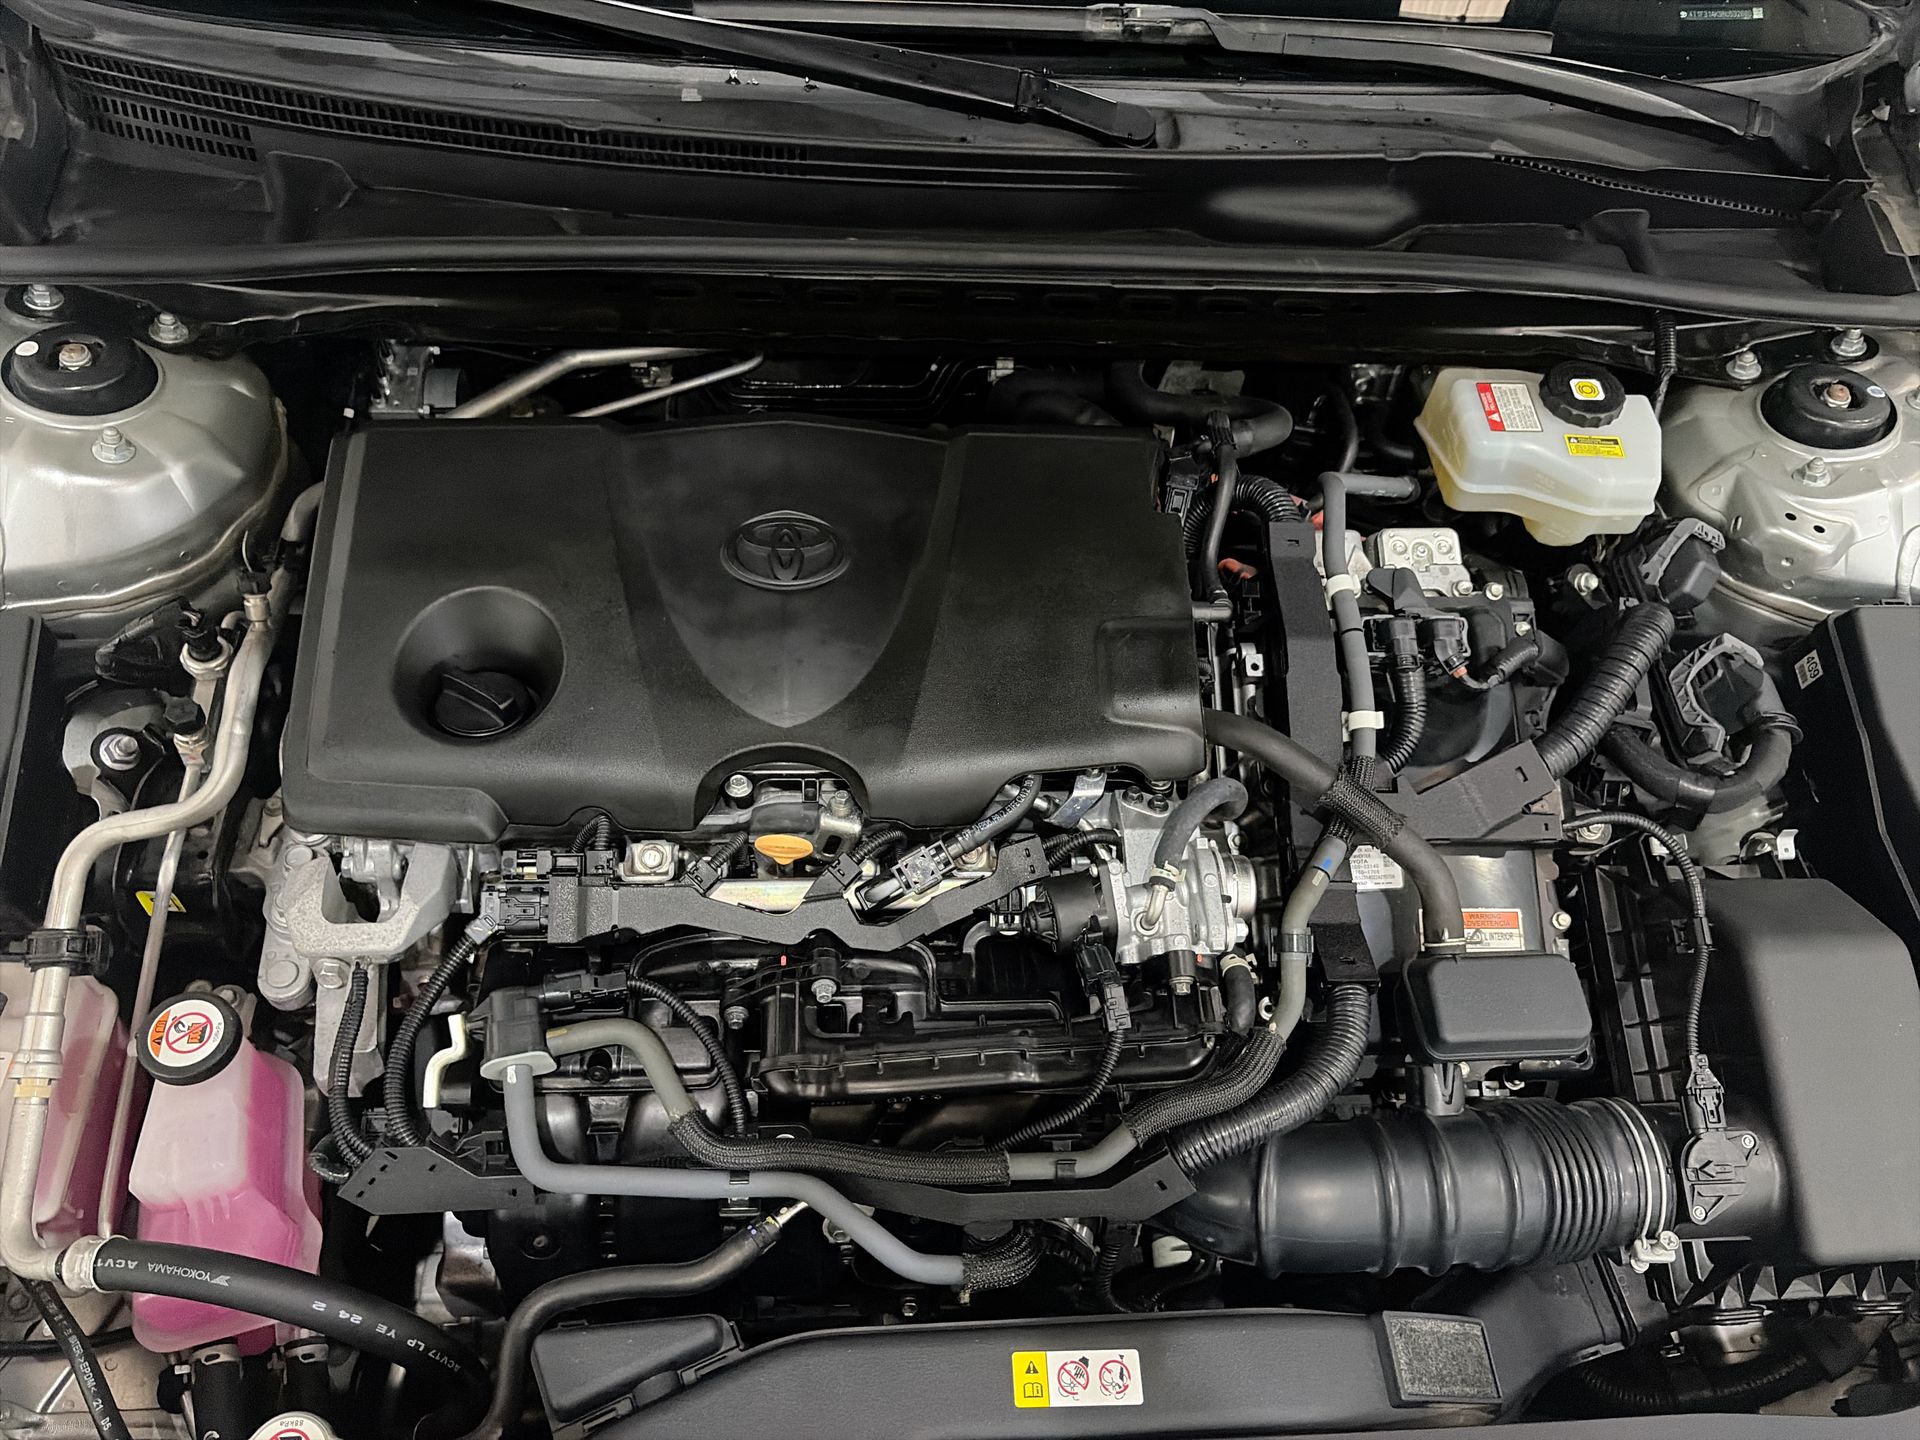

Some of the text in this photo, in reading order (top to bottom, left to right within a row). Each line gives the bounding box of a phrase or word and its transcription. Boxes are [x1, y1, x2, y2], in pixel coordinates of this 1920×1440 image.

[1806, 656, 1820, 679] 4G9
[96, 1258, 210, 1281] YOKOHAMA ACV1
[312, 1300, 461, 1372] ACV17 LP YE 24 2
[92, 1398, 104, 1411] 21
